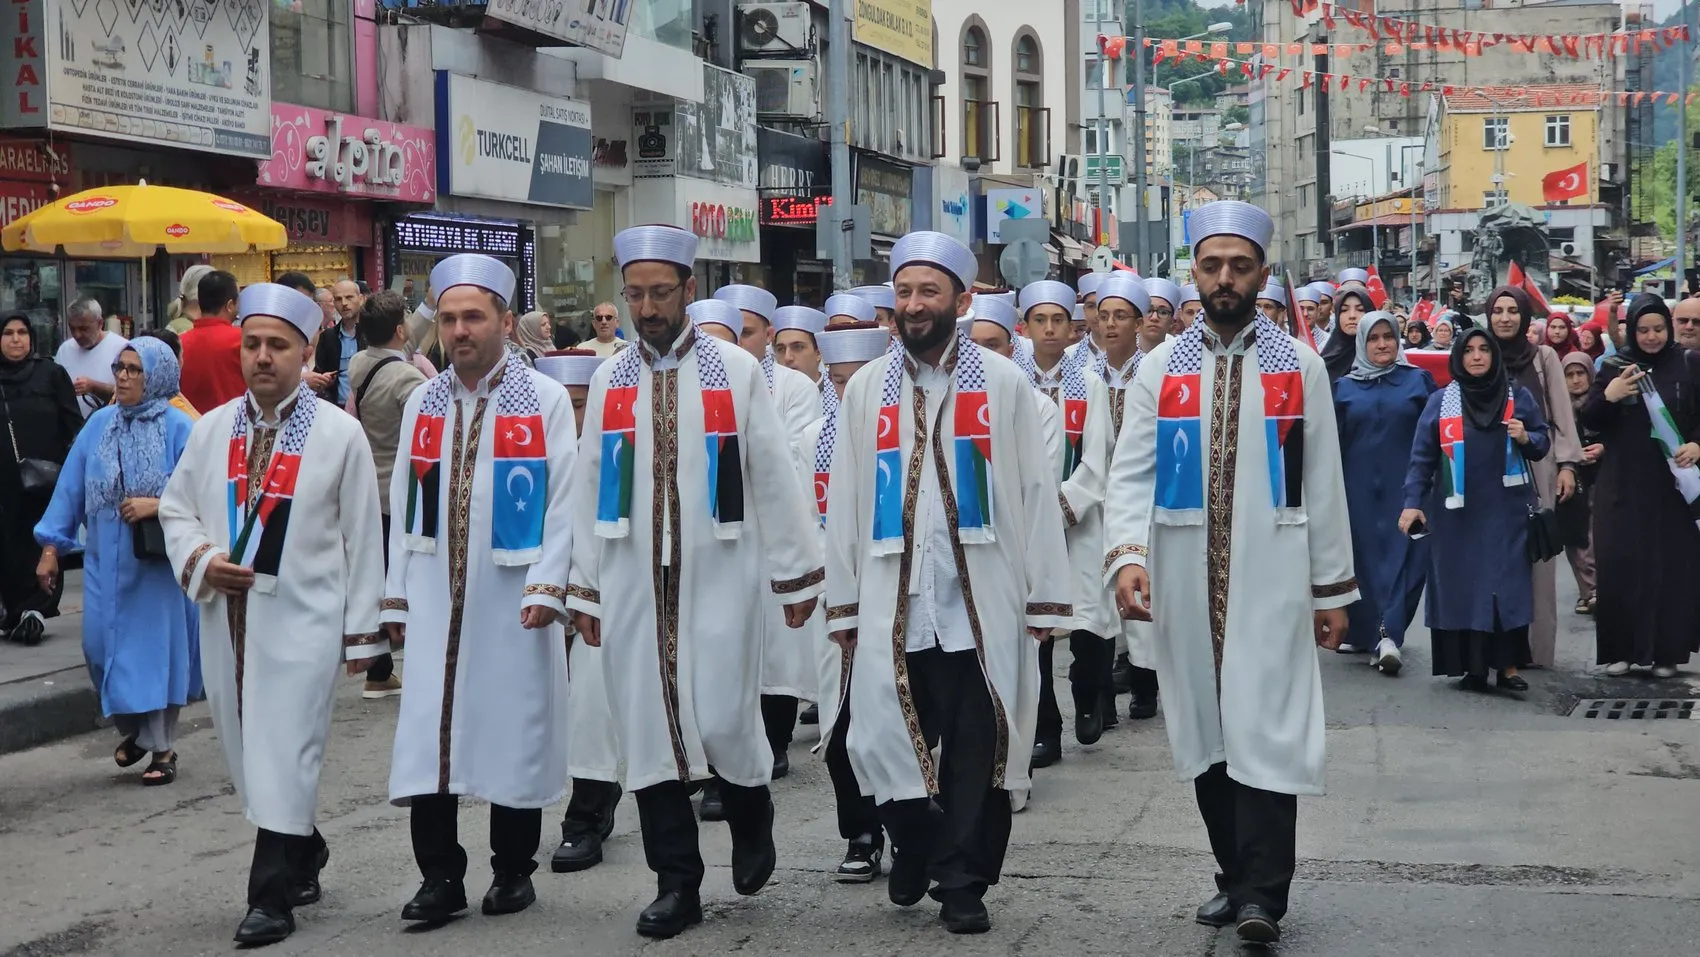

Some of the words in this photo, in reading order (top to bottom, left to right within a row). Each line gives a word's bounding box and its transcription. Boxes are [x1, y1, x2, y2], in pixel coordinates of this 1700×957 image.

[12, 0, 39, 113] İKAL
[306, 116, 405, 192] alpin
[477, 129, 531, 164] TURKCELL
[540, 153, 563, 175] ŞAHAN
[563, 153, 589, 180] İLETİŞİM
[692, 201, 726, 239] FOTO
[464, 228, 479, 250] EK
